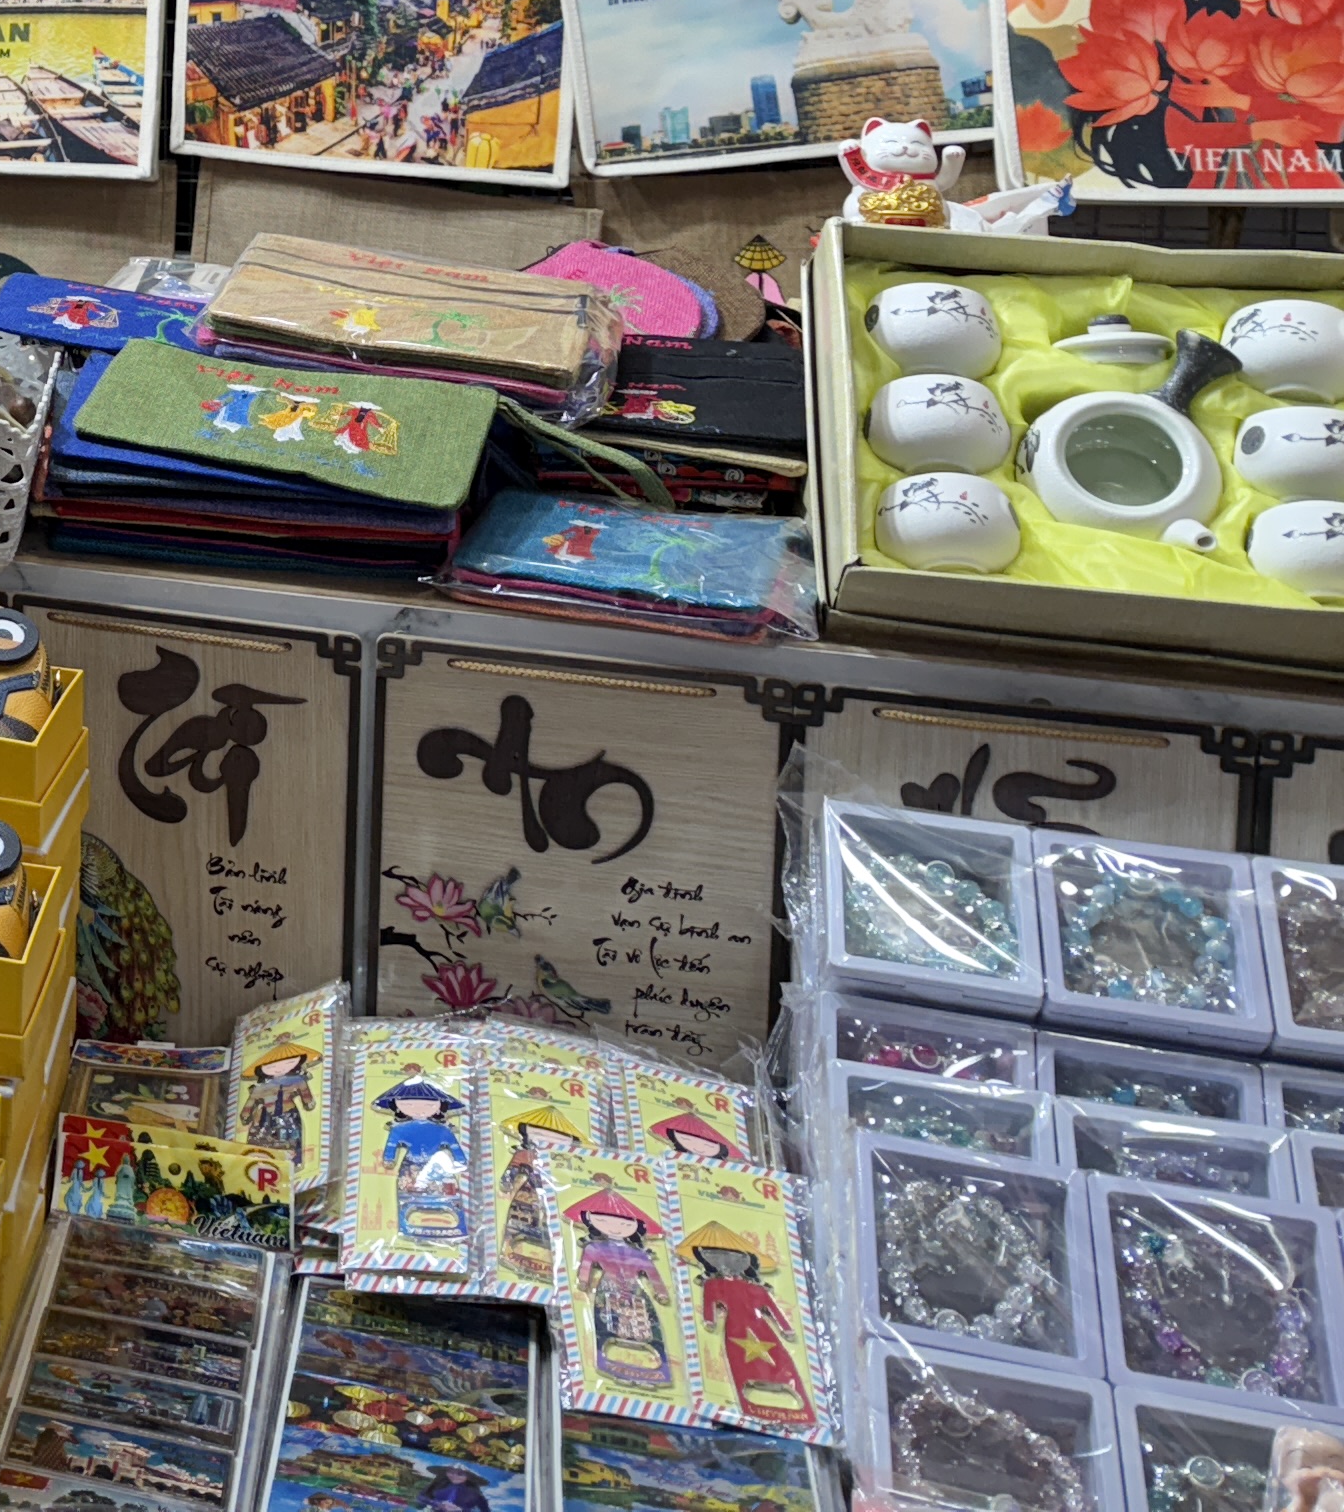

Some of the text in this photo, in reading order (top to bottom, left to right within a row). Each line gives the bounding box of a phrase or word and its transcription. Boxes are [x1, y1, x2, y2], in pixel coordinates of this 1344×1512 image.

[1166, 144, 1344, 173] VIET NAM
[192, 1215, 288, 1247] Vietnam
